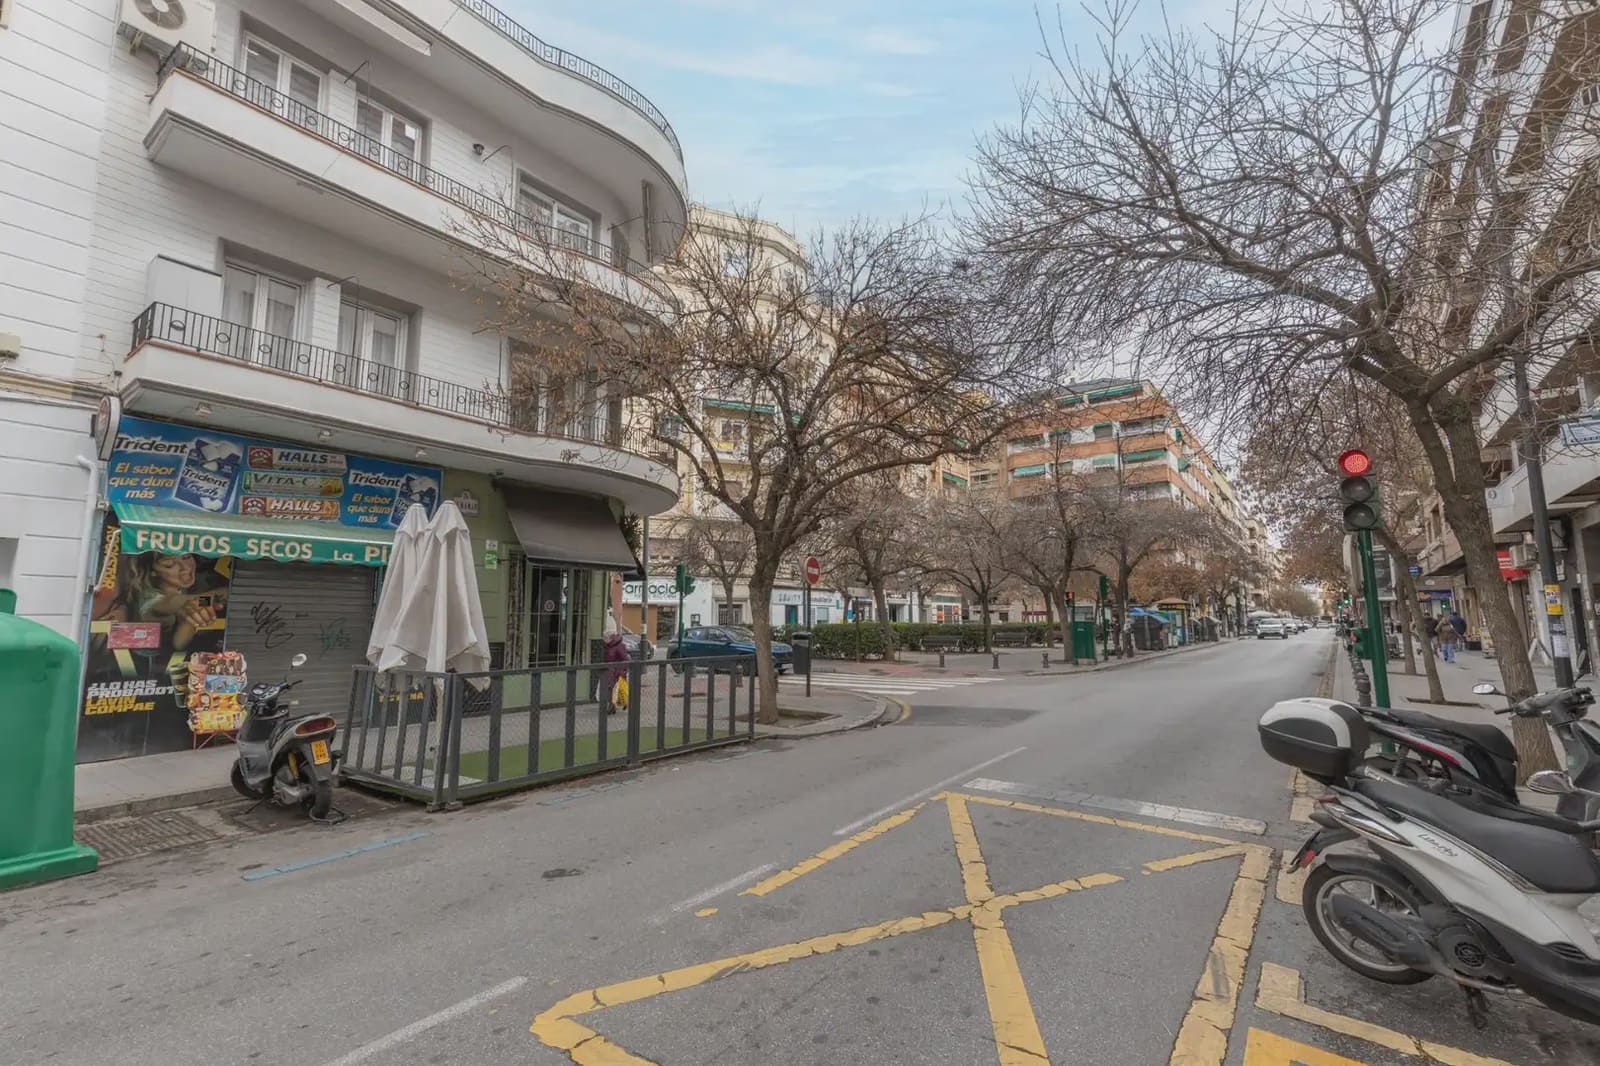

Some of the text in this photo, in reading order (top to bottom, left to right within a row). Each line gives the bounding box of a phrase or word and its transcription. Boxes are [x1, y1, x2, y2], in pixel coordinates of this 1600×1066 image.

[115, 437, 188, 454] Trident
[278, 451, 328, 464] HALLS
[115, 462, 175, 475] El sabor
[109, 476, 175, 488] que dura
[182, 468, 228, 487] Trident
[352, 472, 400, 487] Trident
[125, 487, 155, 499] más
[364, 494, 391, 504] sabor
[271, 500, 321, 511] HALLS
[347, 504, 367, 514] que
[369, 503, 392, 514] dura
[358, 514, 378, 523] más
[137, 530, 230, 554] FRUTOS
[247, 539, 312, 560] SECOS
[333, 550, 352, 561] La
[122, 680, 158, 689] HAS
